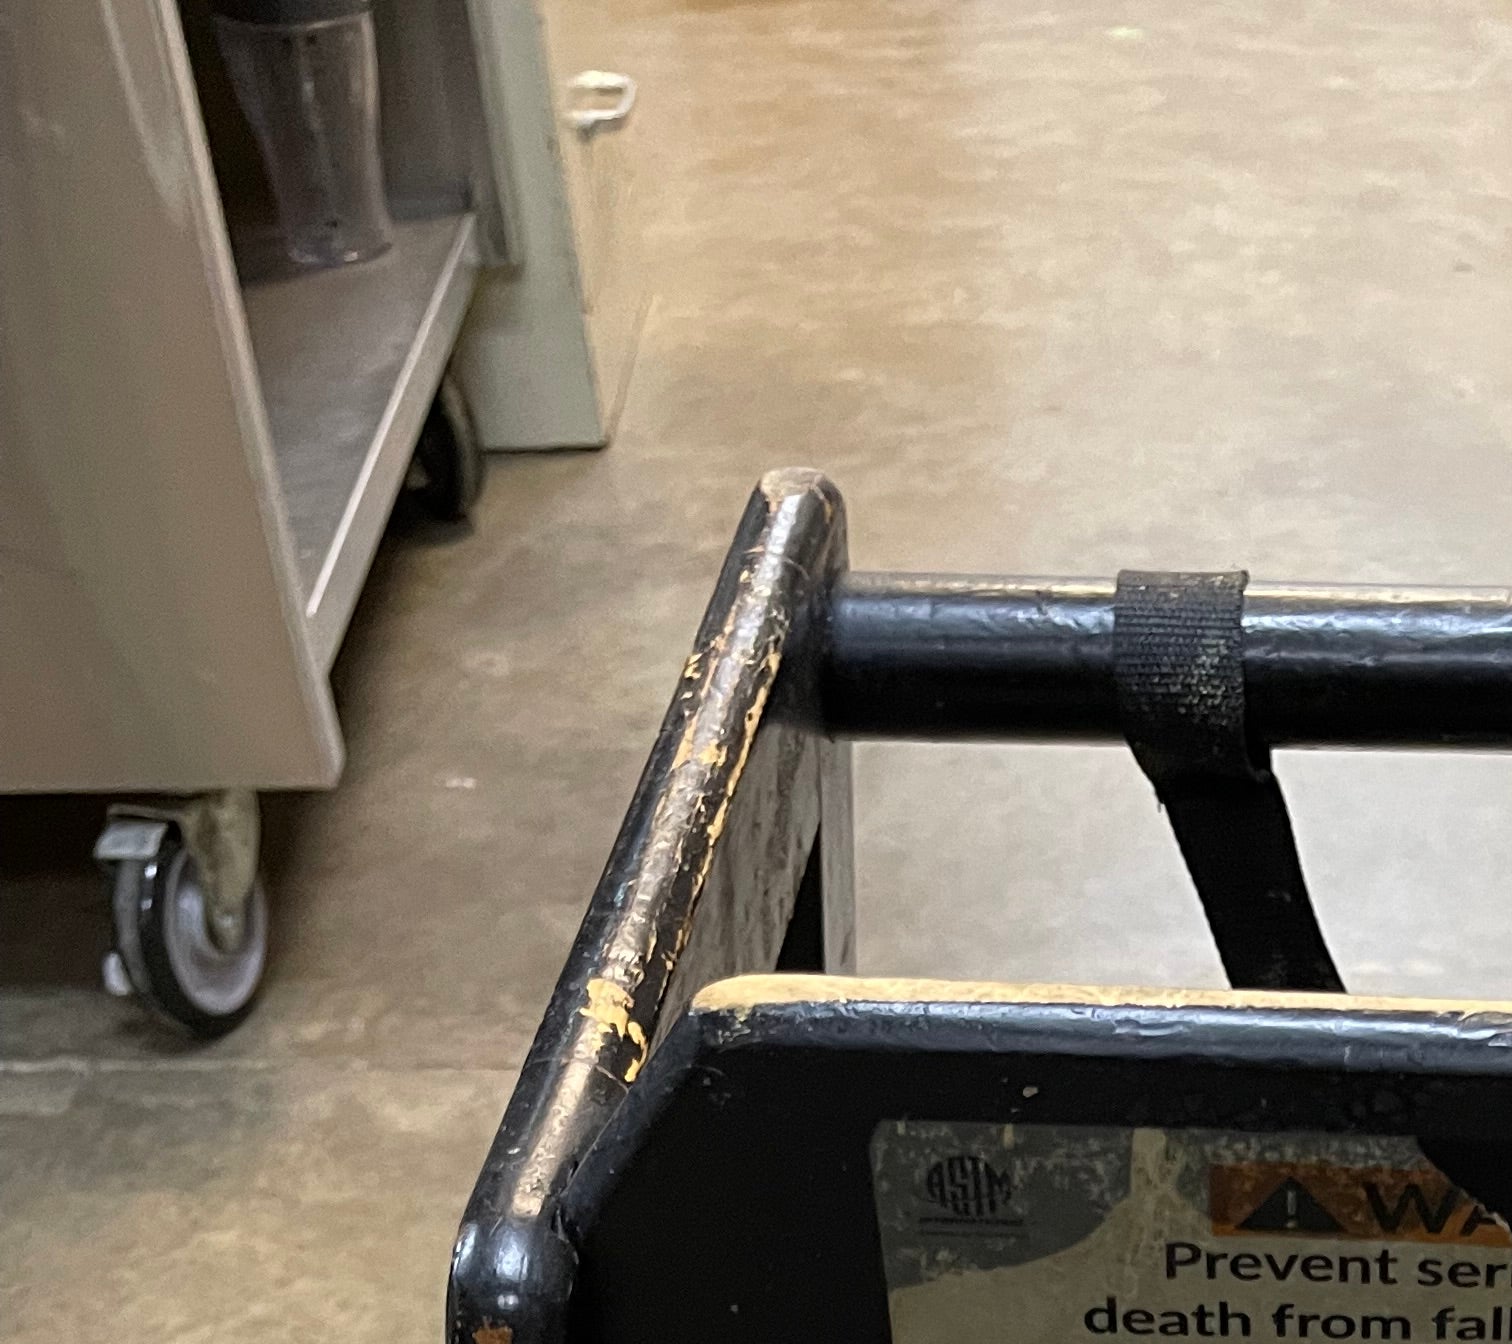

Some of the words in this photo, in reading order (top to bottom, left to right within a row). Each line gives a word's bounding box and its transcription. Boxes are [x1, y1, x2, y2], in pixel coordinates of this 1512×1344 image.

[1165, 1242, 1398, 1284] Prevent
[1084, 1296, 1252, 1337] death
[1273, 1304, 1411, 1341] from
